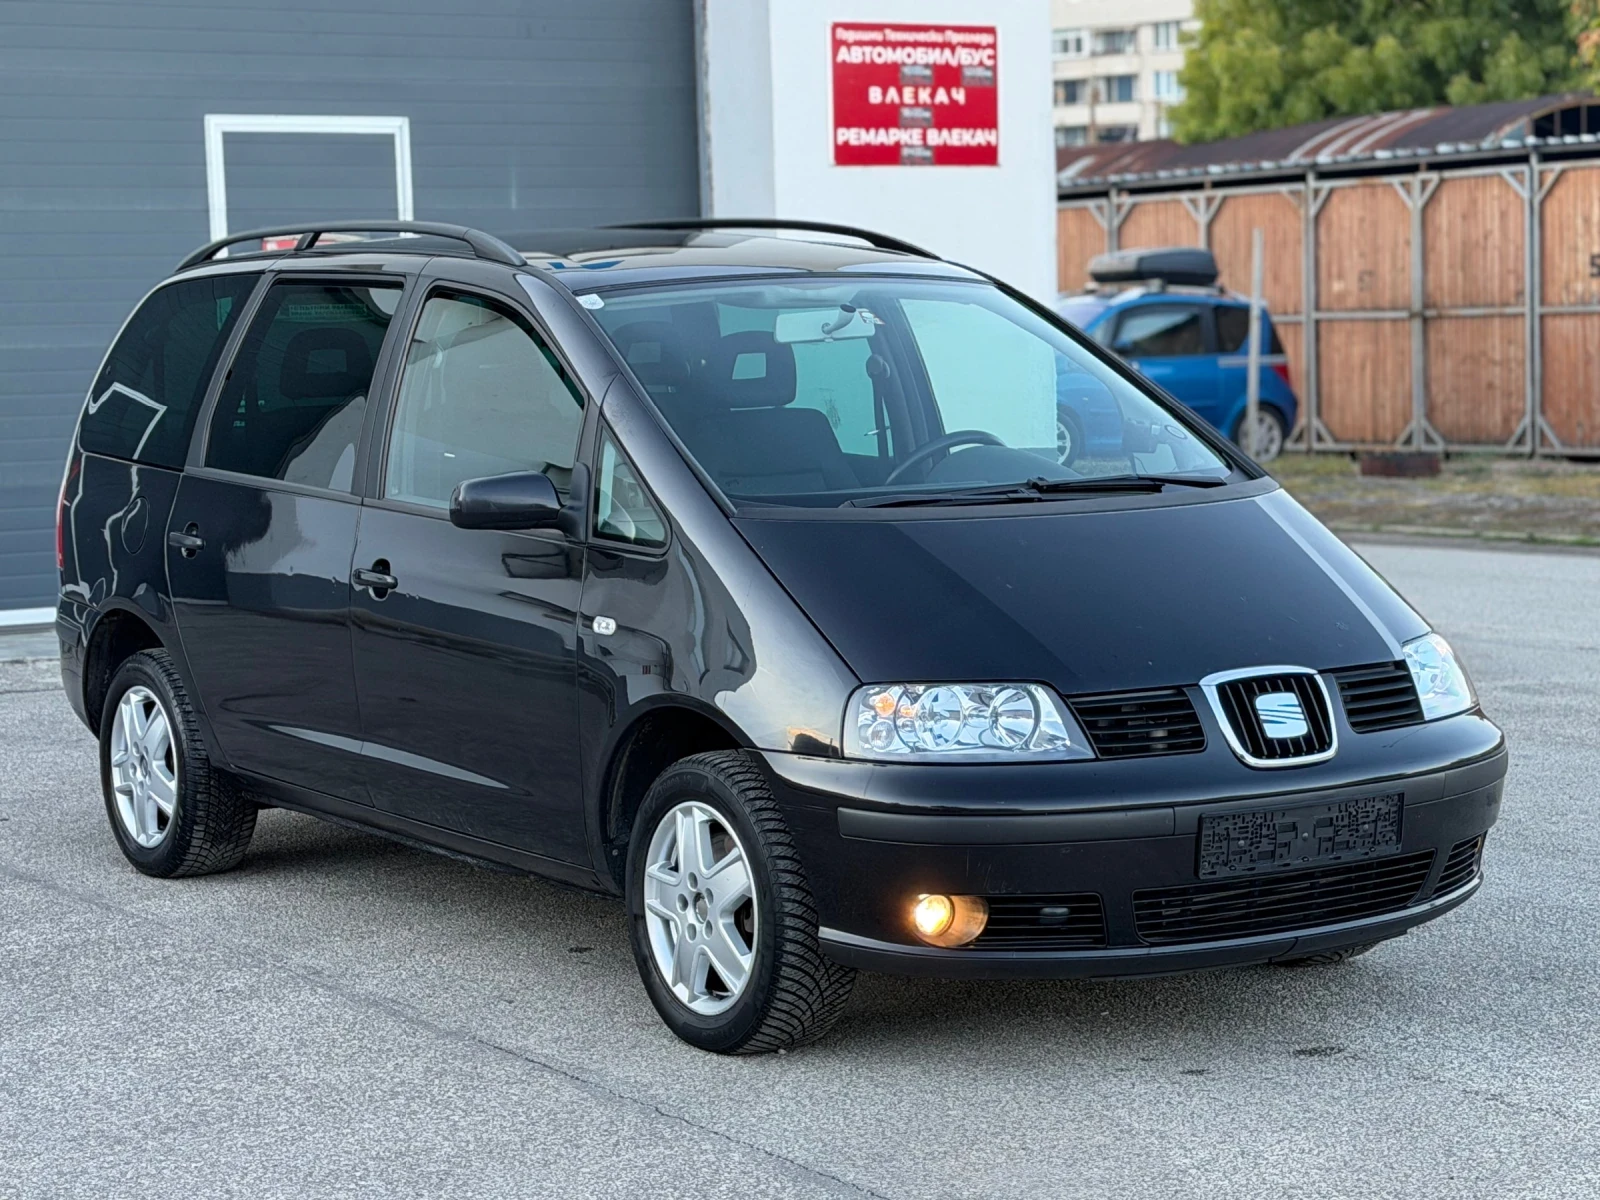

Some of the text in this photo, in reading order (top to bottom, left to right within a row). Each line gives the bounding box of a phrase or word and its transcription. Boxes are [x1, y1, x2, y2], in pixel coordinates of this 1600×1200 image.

[836, 45, 995, 67] АВТОМОБИЛ/БУС
[868, 85, 966, 105] ВЛЕКАЧ
[836, 127, 997, 147] РЕМАРКЕ ВЛЕКАЧ
